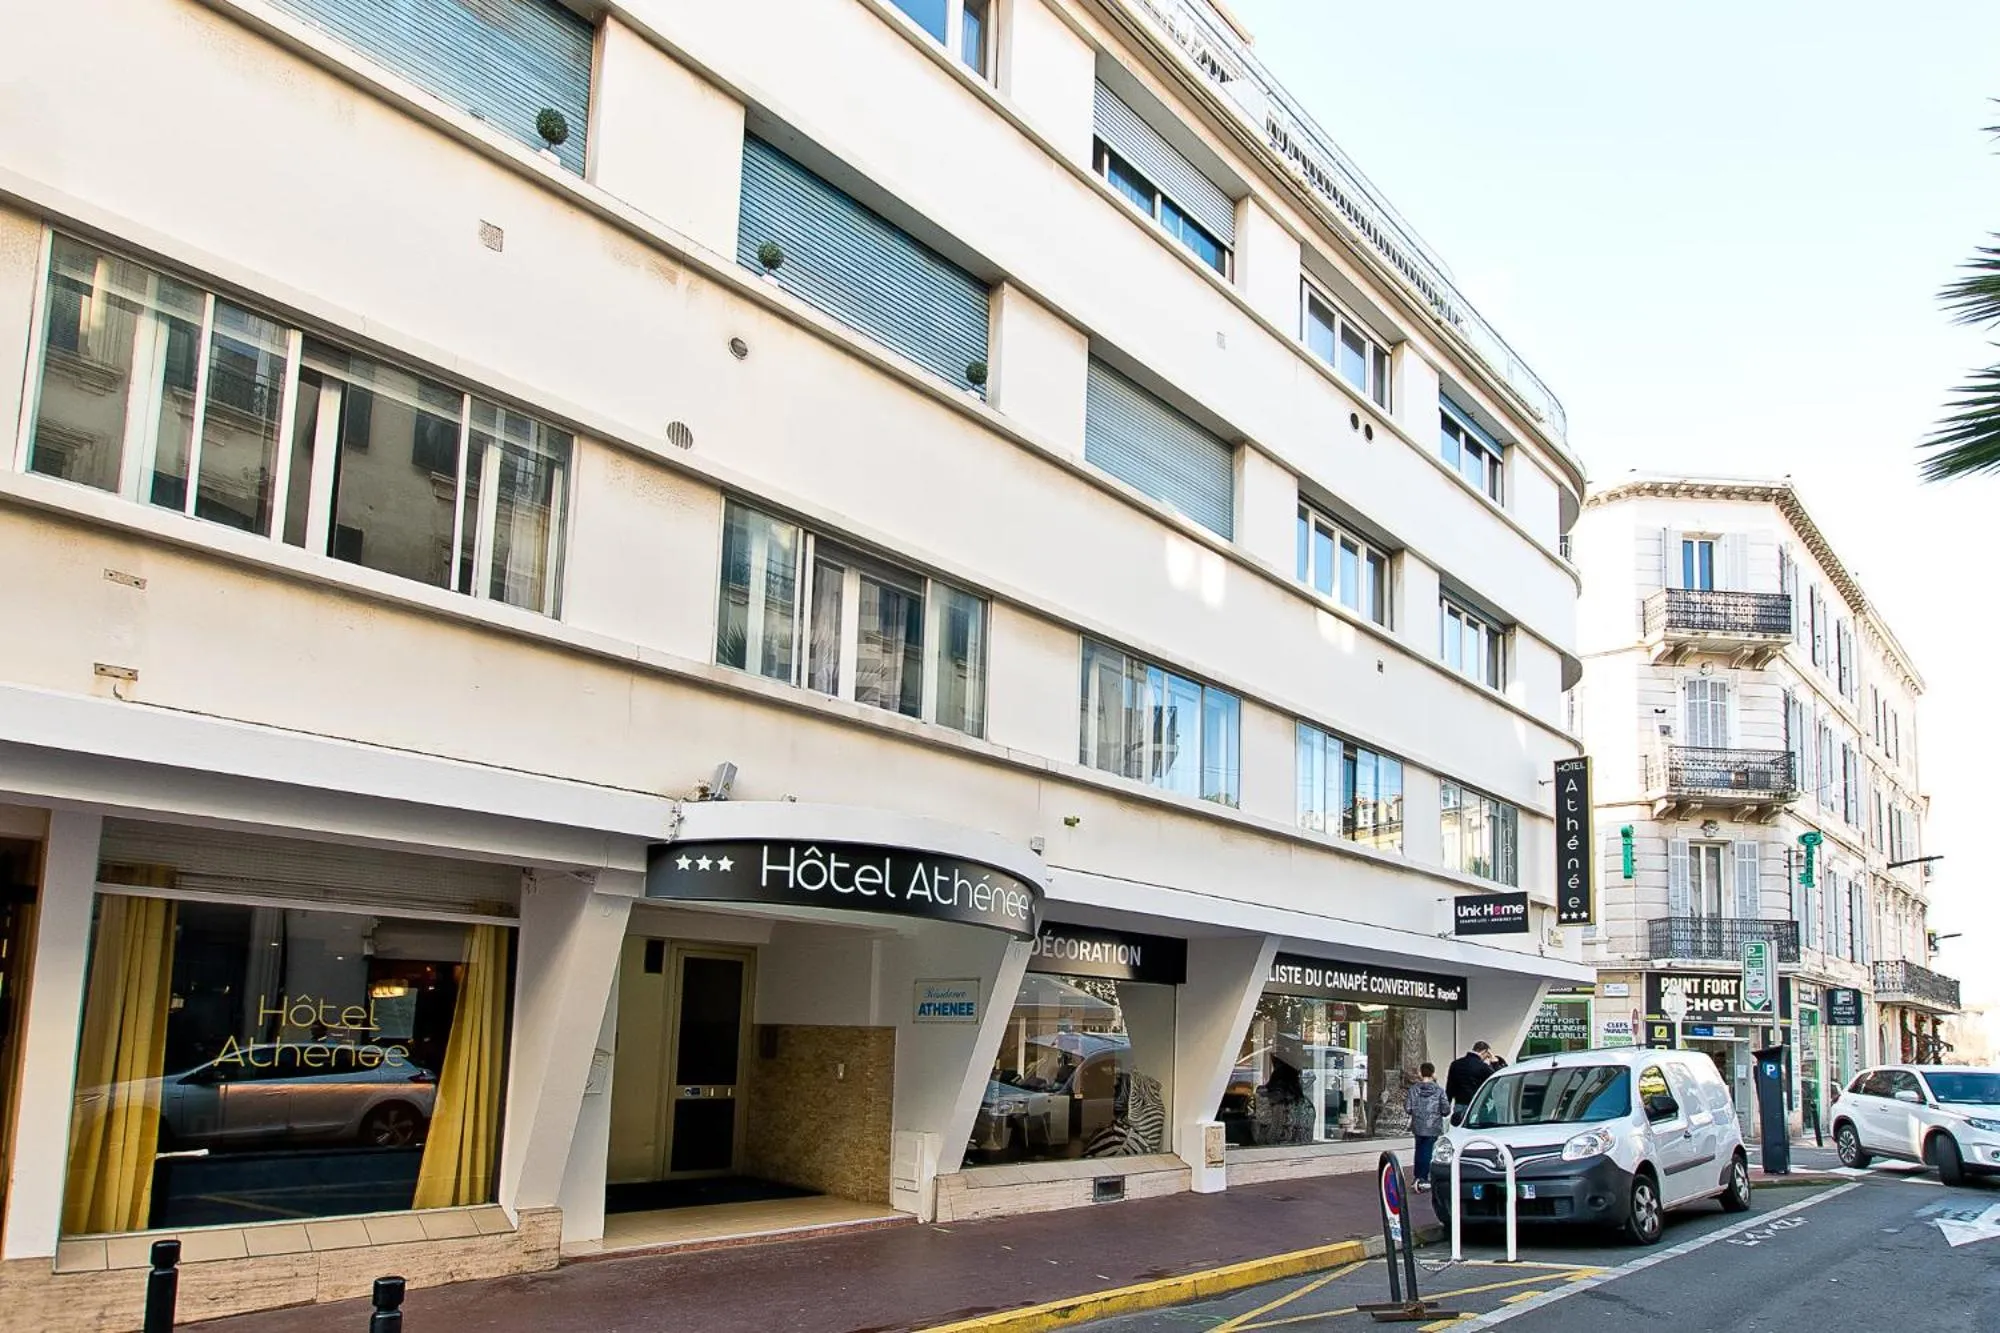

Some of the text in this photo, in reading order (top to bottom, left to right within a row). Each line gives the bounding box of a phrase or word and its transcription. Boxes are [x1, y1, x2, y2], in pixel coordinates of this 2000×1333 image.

[1556, 761, 1586, 773] HÔTEL
[1564, 778, 1581, 909] Athénée
[760, 844, 1031, 921] Hôtel Athénée
[1267, 964, 1301, 986] LISTE
[1305, 968, 1322, 987] DU
[1325, 970, 1368, 992] CANAPÉ
[1370, 976, 1435, 999] CONVERTIBLE
[1704, 979, 1738, 995] FORT
[258, 994, 377, 1028] Hôtel
[918, 1001, 975, 1017] ATHENEE
[213, 1035, 410, 1068] Athénée
[1766, 1064, 1776, 1075] P
